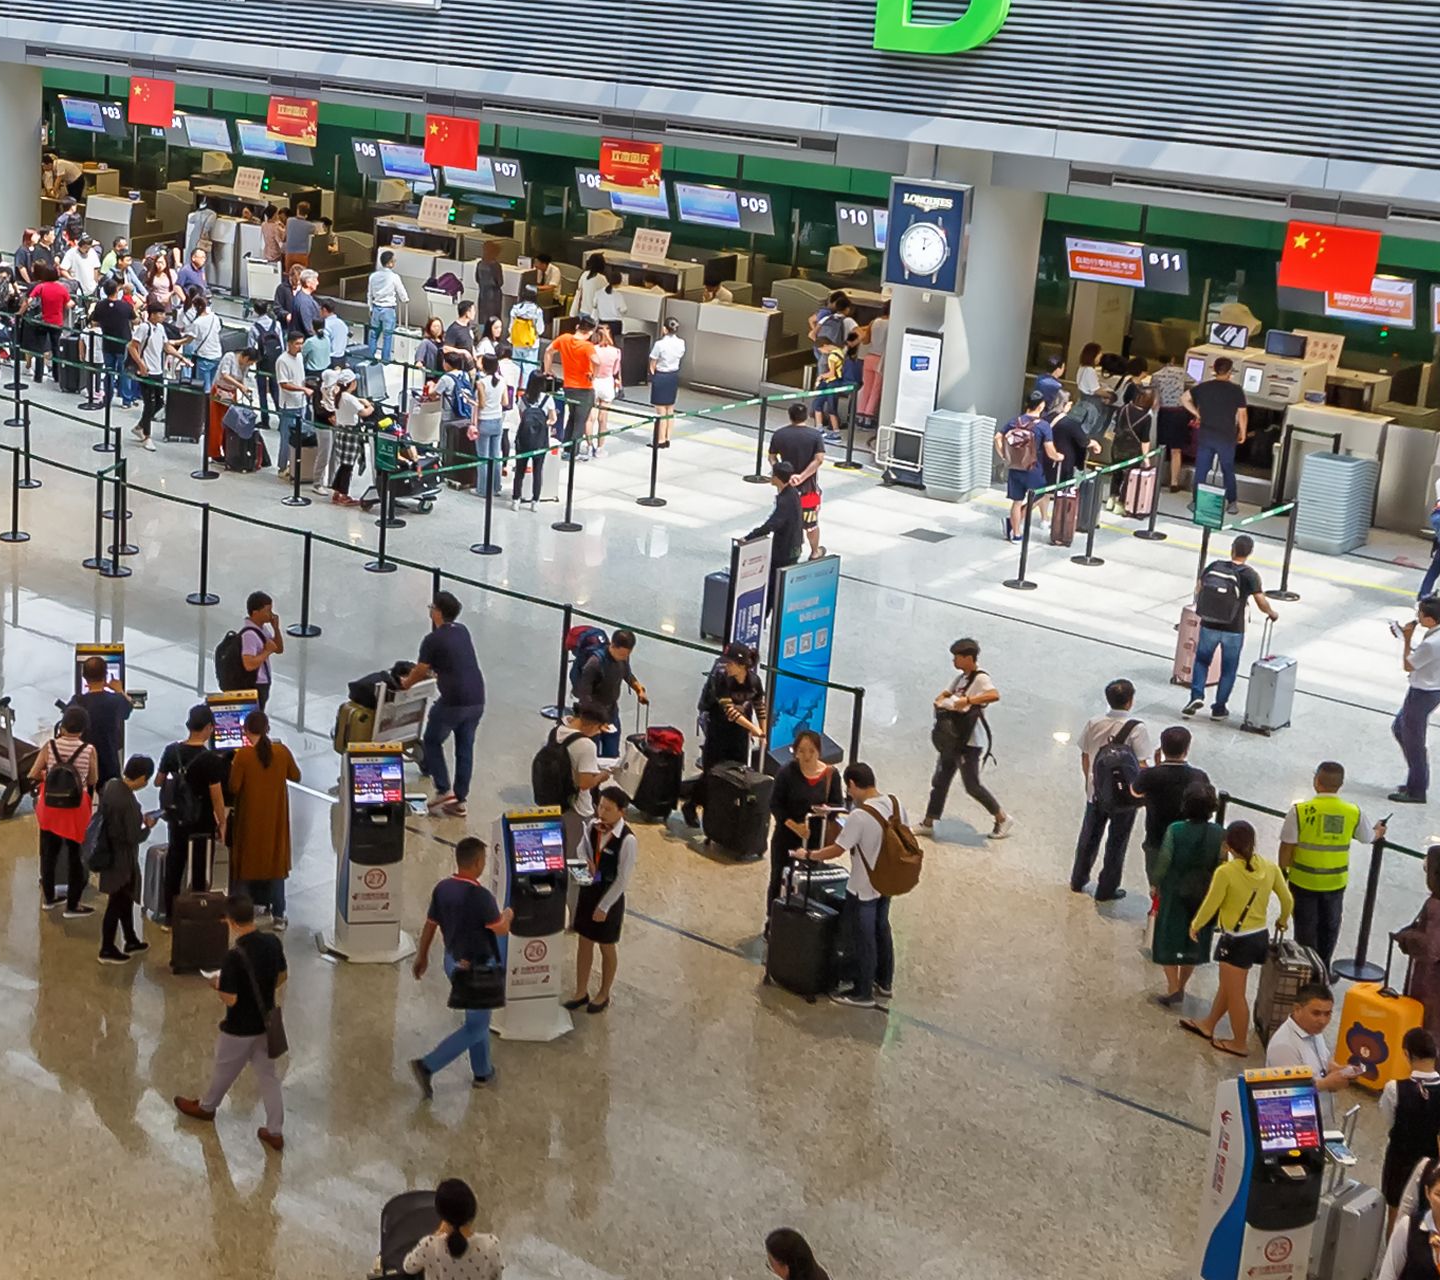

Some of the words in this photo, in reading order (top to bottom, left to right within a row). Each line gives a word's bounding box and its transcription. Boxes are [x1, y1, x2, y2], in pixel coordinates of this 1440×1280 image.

[355, 142, 377, 158] B06
[494, 161, 517, 177] B07
[740, 196, 768, 214] B09
[903, 193, 954, 209] LONGINES
[839, 208, 868, 226] B10
[1149, 252, 1181, 271] B11
